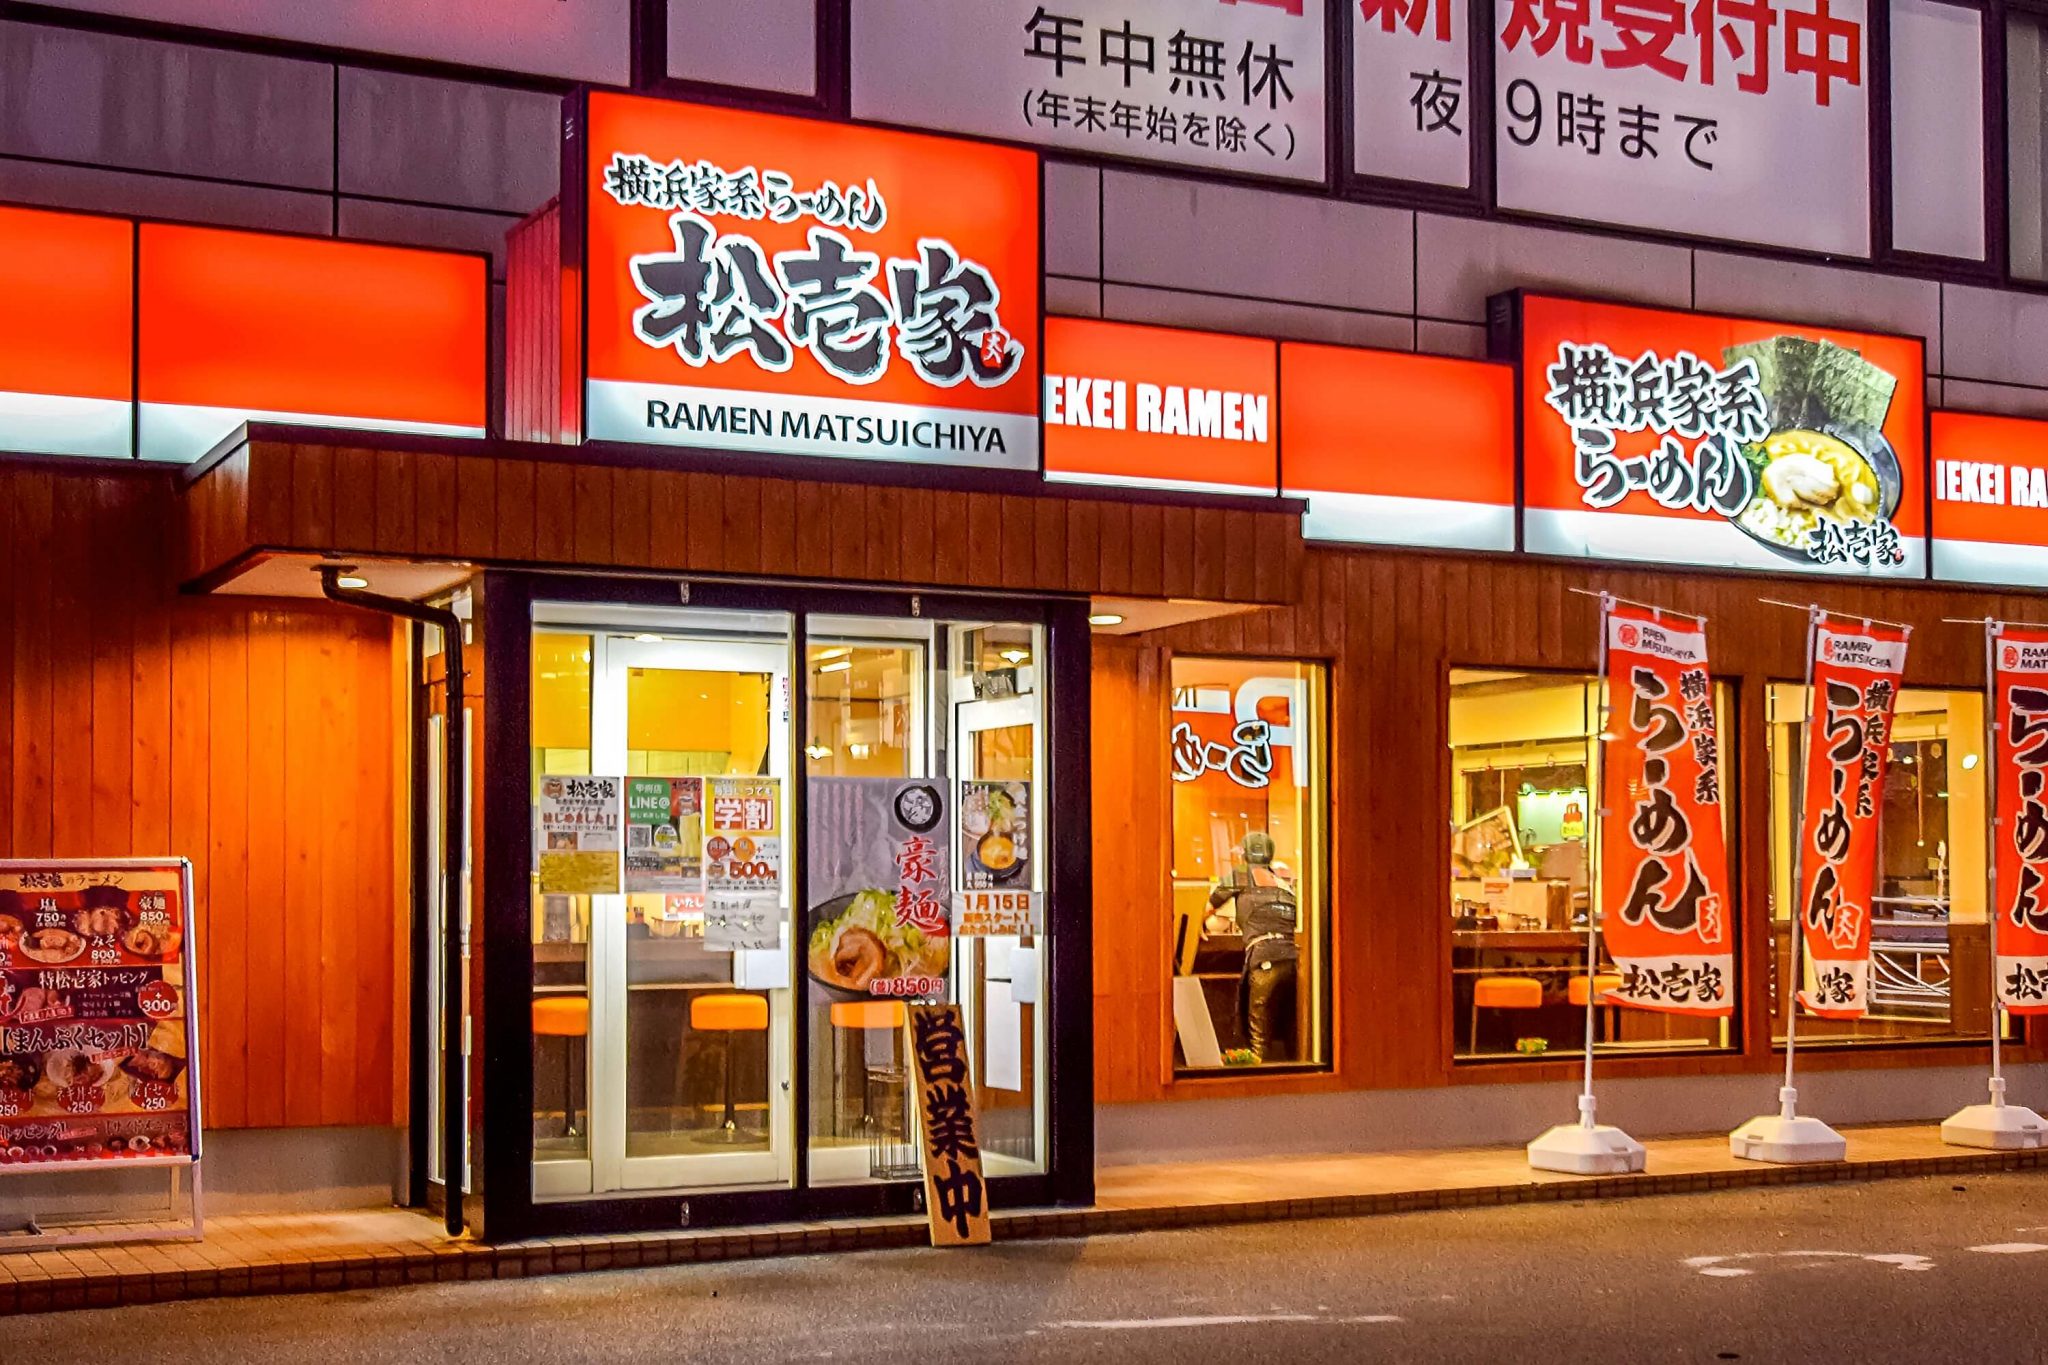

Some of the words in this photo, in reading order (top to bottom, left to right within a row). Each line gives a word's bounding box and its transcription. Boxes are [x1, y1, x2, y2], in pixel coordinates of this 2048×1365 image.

[1023, 6, 1295, 110] 年中無休
[1022, 87, 1297, 161] (年末年始を除く)
[605, 154, 887, 233] 横浜家系らーめん
[632, 215, 1025, 386] 松壱家
[647, 400, 772, 437] RAMEN
[780, 410, 1008, 454] MATSUICHIYA
[1136, 382, 1269, 443] RAMEN
[1545, 341, 1772, 444] 横浜家系
[1575, 420, 1755, 517] らーめん
[1935, 459, 2005, 506] IEKEI
[2010, 465, 2048, 510] RA
[1808, 516, 1906, 567] 松壱家
[1680, 671, 1719, 804] 横浜家系
[629, 796, 671, 810] LINE@
[714, 798, 774, 831] 学割
[1620, 667, 1709, 934] らーめん
[895, 836, 945, 932] 豪麺
[963, 893, 1030, 911] 1月15日
[1619, 962, 1723, 1002] 松壱家
[914, 1010, 984, 1239] 営業中
